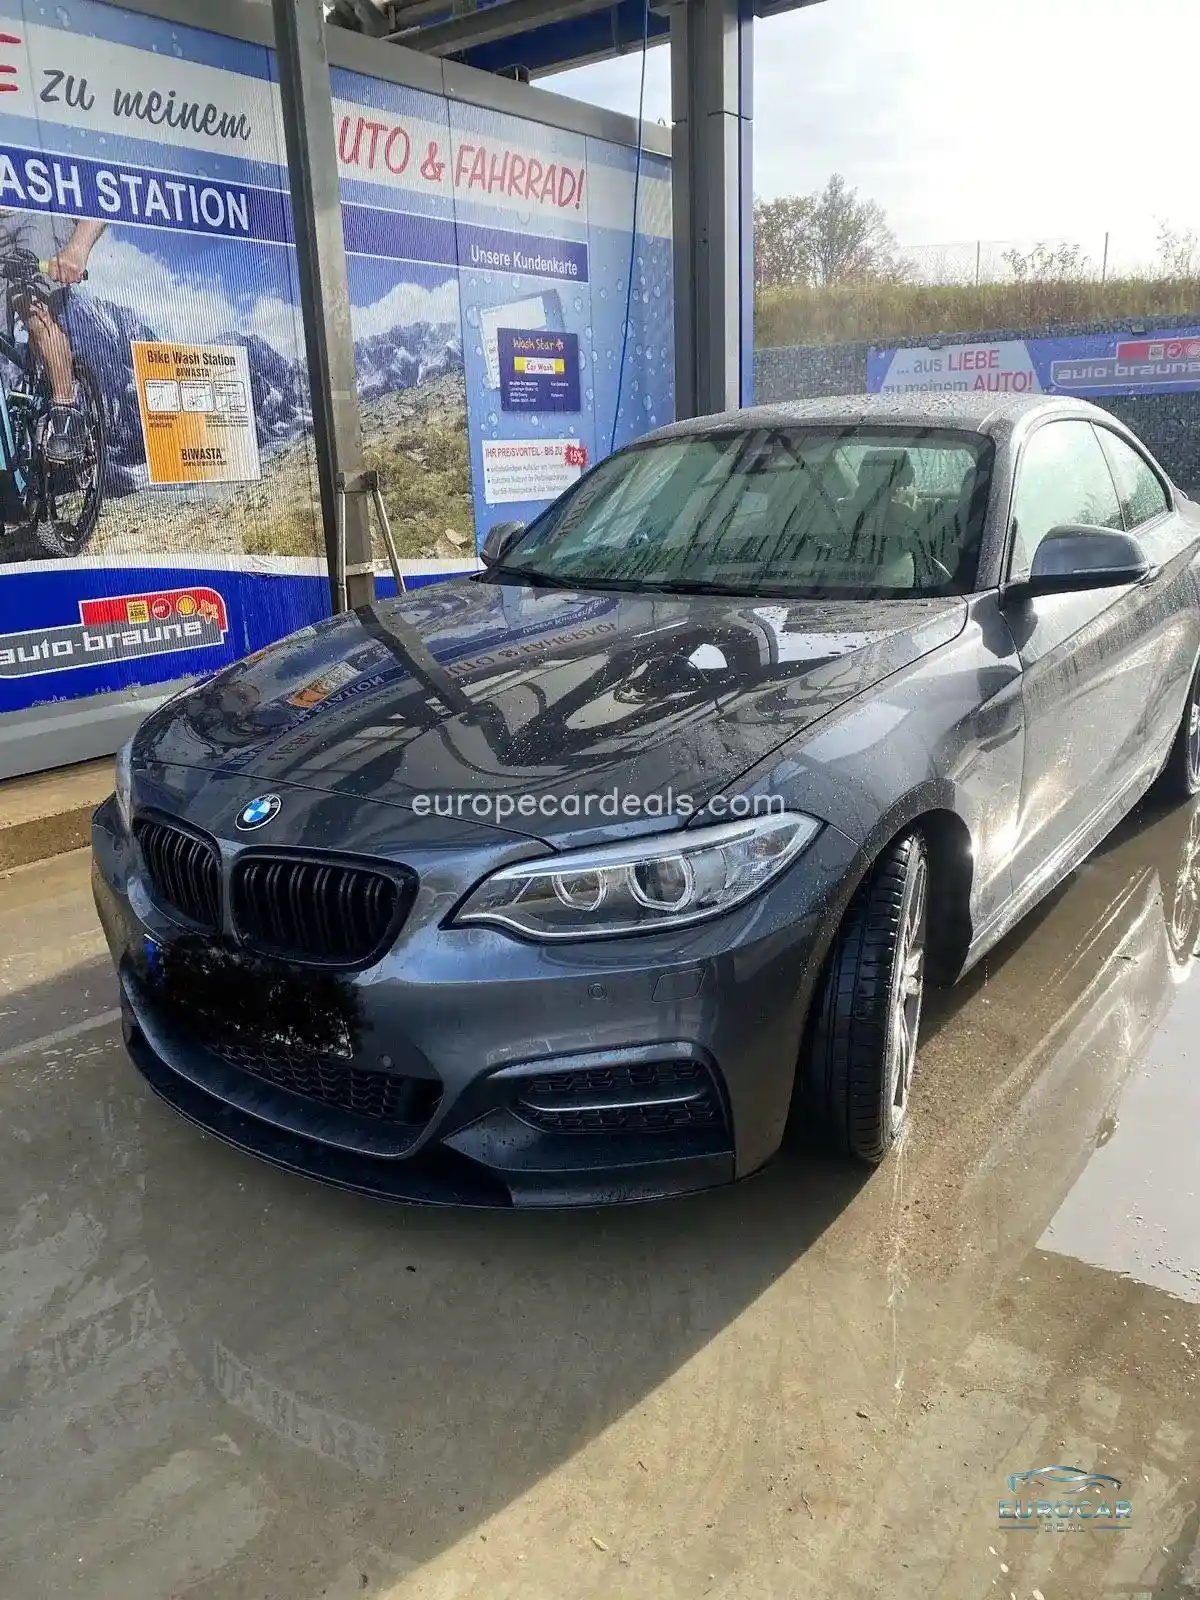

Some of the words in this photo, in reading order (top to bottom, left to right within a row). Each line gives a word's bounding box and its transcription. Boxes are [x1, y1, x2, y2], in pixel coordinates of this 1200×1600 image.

[40, 69, 95, 111] zu
[113, 87, 251, 141] meinem
[339, 115, 410, 174] UTO
[420, 141, 445, 182] &
[454, 143, 585, 210] FAHRRAD!
[0, 153, 83, 208] ASH
[96, 170, 249, 231] STATION
[471, 244, 511, 267] Unsere
[513, 249, 578, 276] Kundenkarte
[513, 337, 536, 349] Wash
[536, 338, 554, 351] Star
[147, 350, 169, 364] Bike
[172, 351, 200, 365] Wash
[203, 353, 236, 367] Station
[912, 358, 943, 374] aus
[948, 349, 1001, 372] LIEBE
[176, 367, 211, 378] BIWASTA
[972, 371, 1033, 393] AUTO!
[181, 448, 222, 460] BIWASTA
[569, 450, 584, 463] 15%
[0, 620, 201, 666] auto-braune
